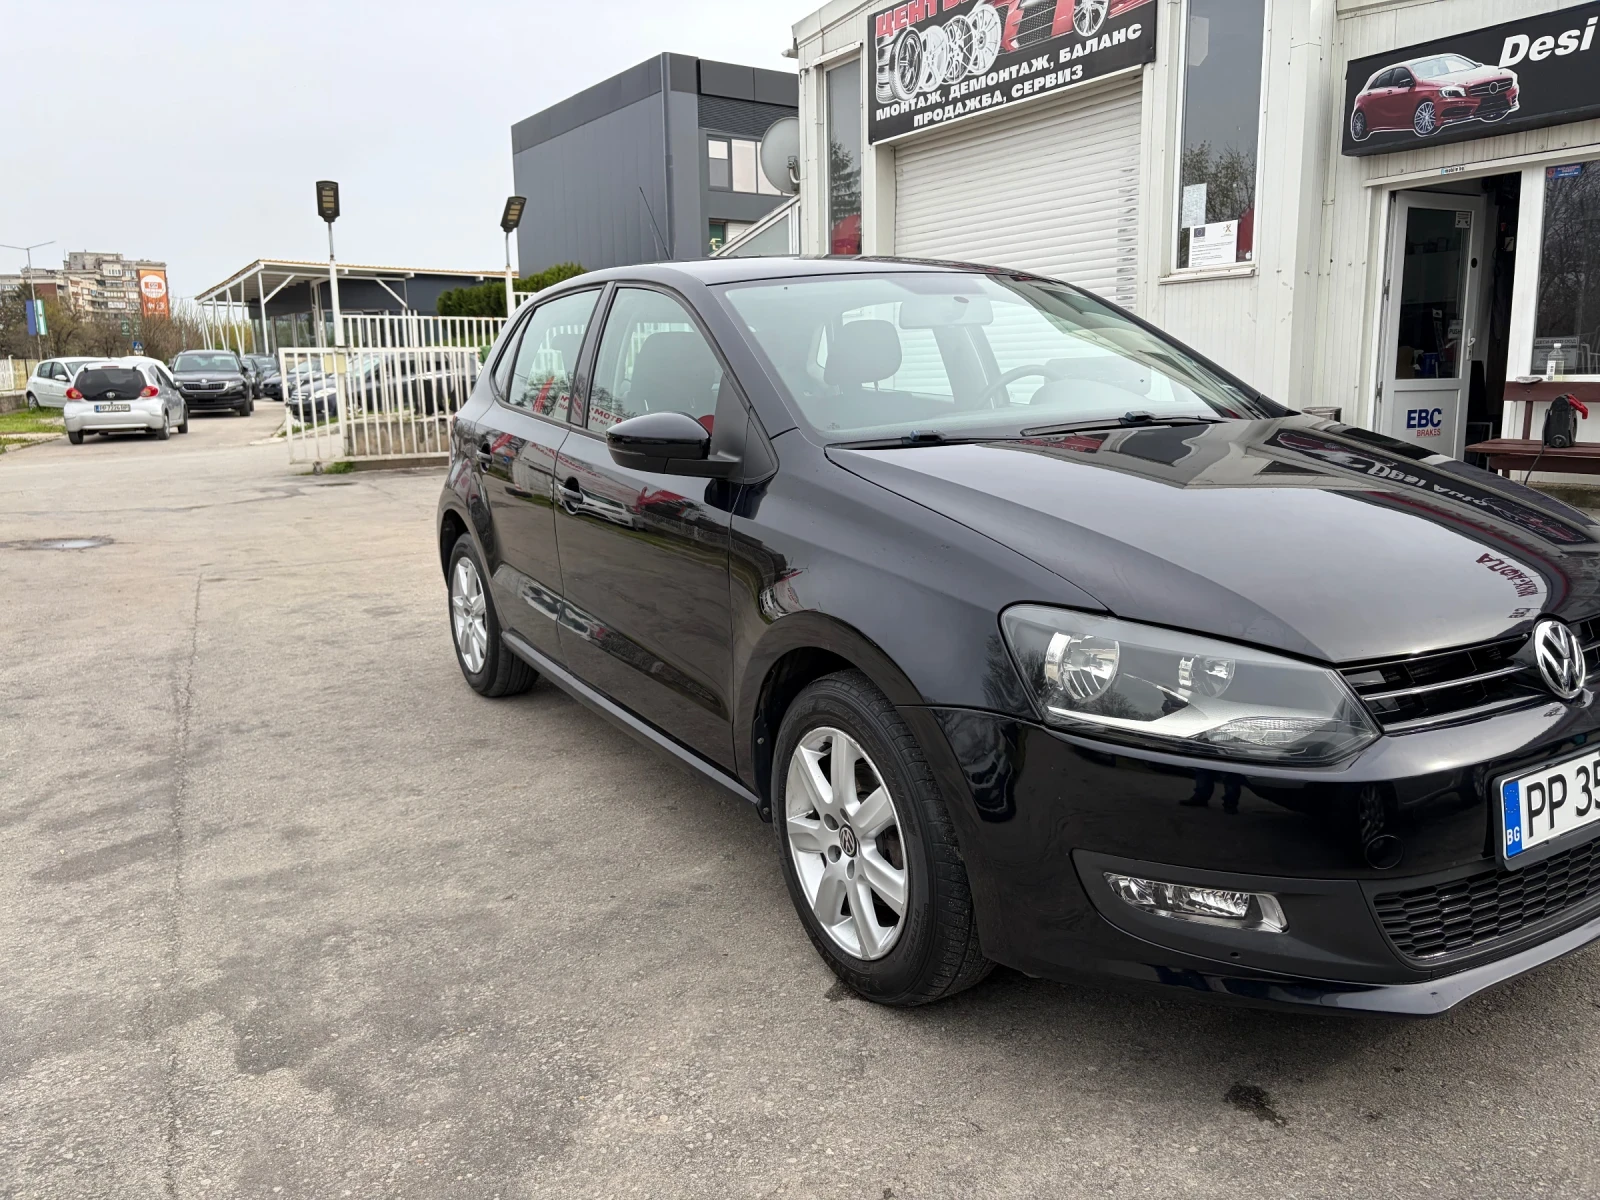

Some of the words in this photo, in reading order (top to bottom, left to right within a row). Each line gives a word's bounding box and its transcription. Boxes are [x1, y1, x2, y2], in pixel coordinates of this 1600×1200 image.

[1498, 16, 1599, 69] Desi
[876, 90, 946, 121] МОНТАЖ,
[948, 54, 1054, 102] ДЕМОНТАЖ,
[1059, 23, 1142, 63] БАЛАНС
[913, 89, 1007, 128] ПРОДАЖБА,
[1011, 64, 1084, 98] СЕРВИЗ
[1406, 407, 1442, 429] EBC
[1416, 429, 1441, 437] BRAKES
[1526, 773, 1568, 839] PP
[1506, 825, 1521, 846] BG
